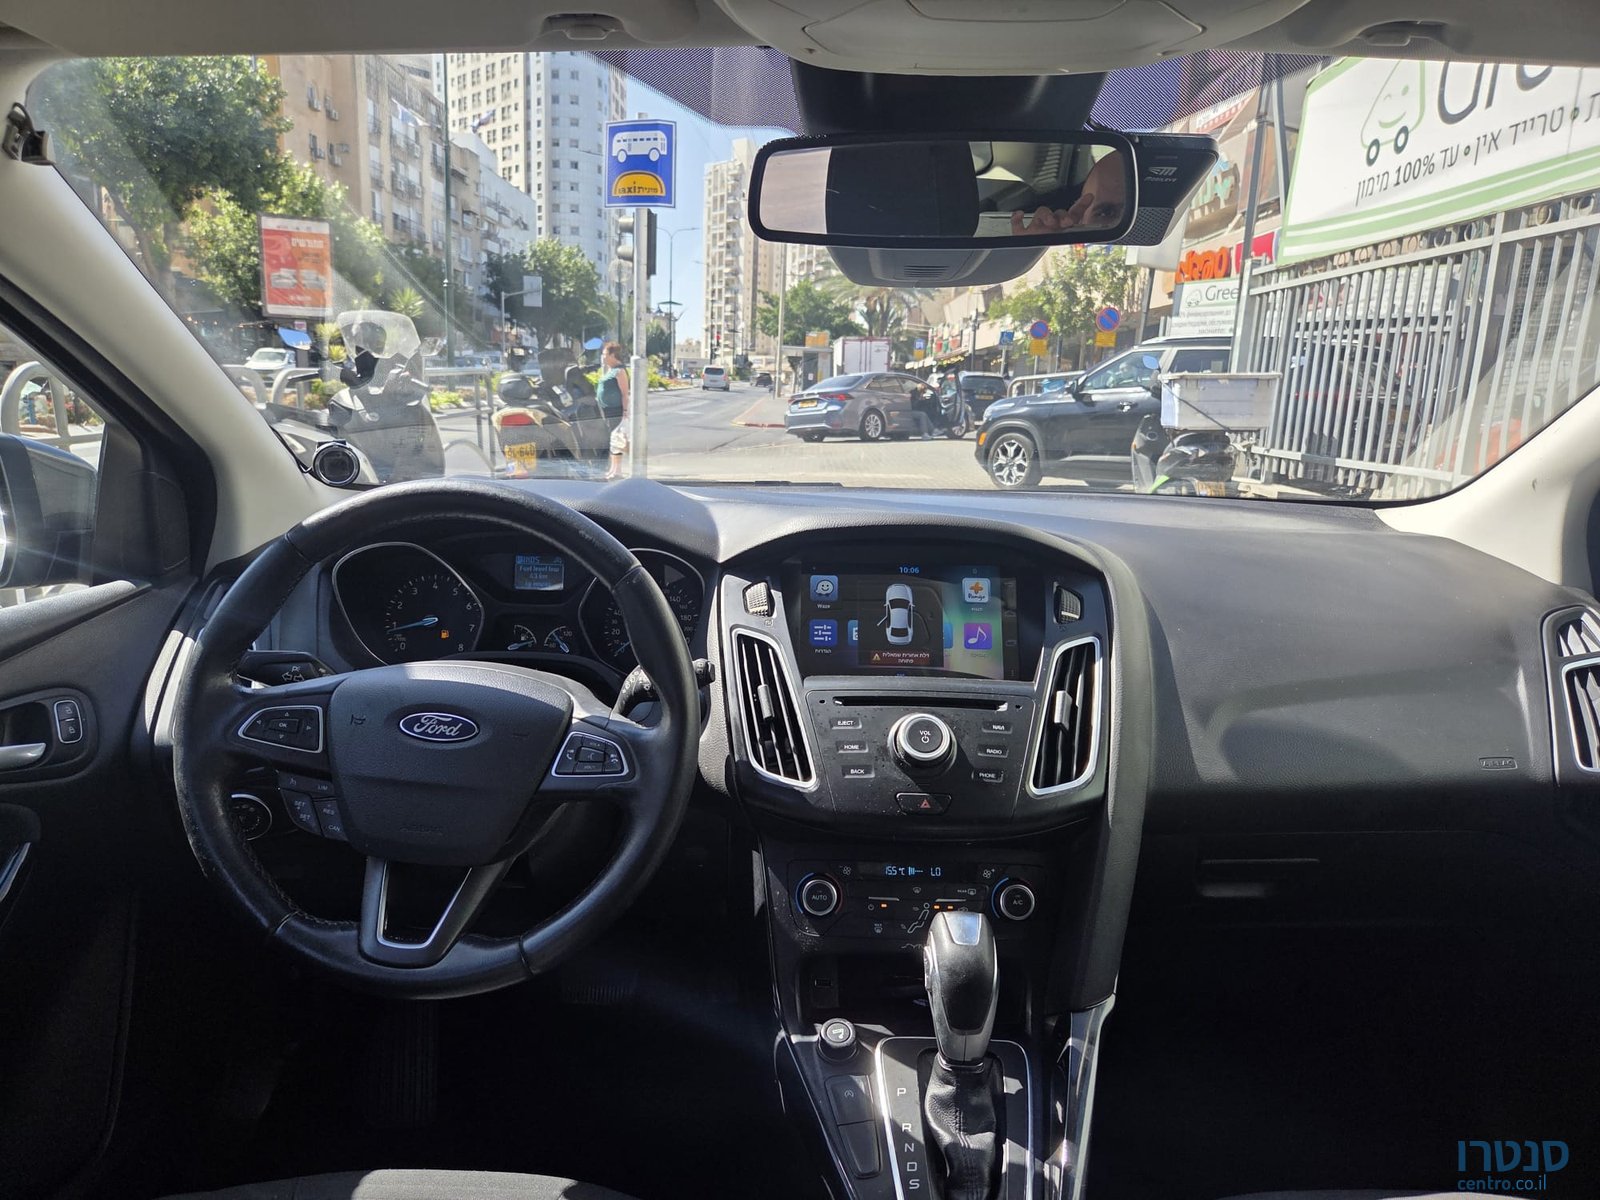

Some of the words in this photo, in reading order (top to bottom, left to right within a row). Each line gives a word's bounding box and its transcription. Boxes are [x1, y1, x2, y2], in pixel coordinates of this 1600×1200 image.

[1508, 106, 1564, 146] טרייד
[1474, 129, 1502, 166] אין
[1440, 144, 1460, 170] עד
[1393, 152, 1436, 187] 100%
[1355, 171, 1390, 207] מימון
[899, 566, 920, 574] 10:06
[413, 714, 463, 737] Ford
[897, 1088, 907, 1097] P
[902, 1123, 912, 1132] R
[904, 1143, 915, 1152] N
[906, 1162, 918, 1172] D
[909, 1179, 920, 1189] S
